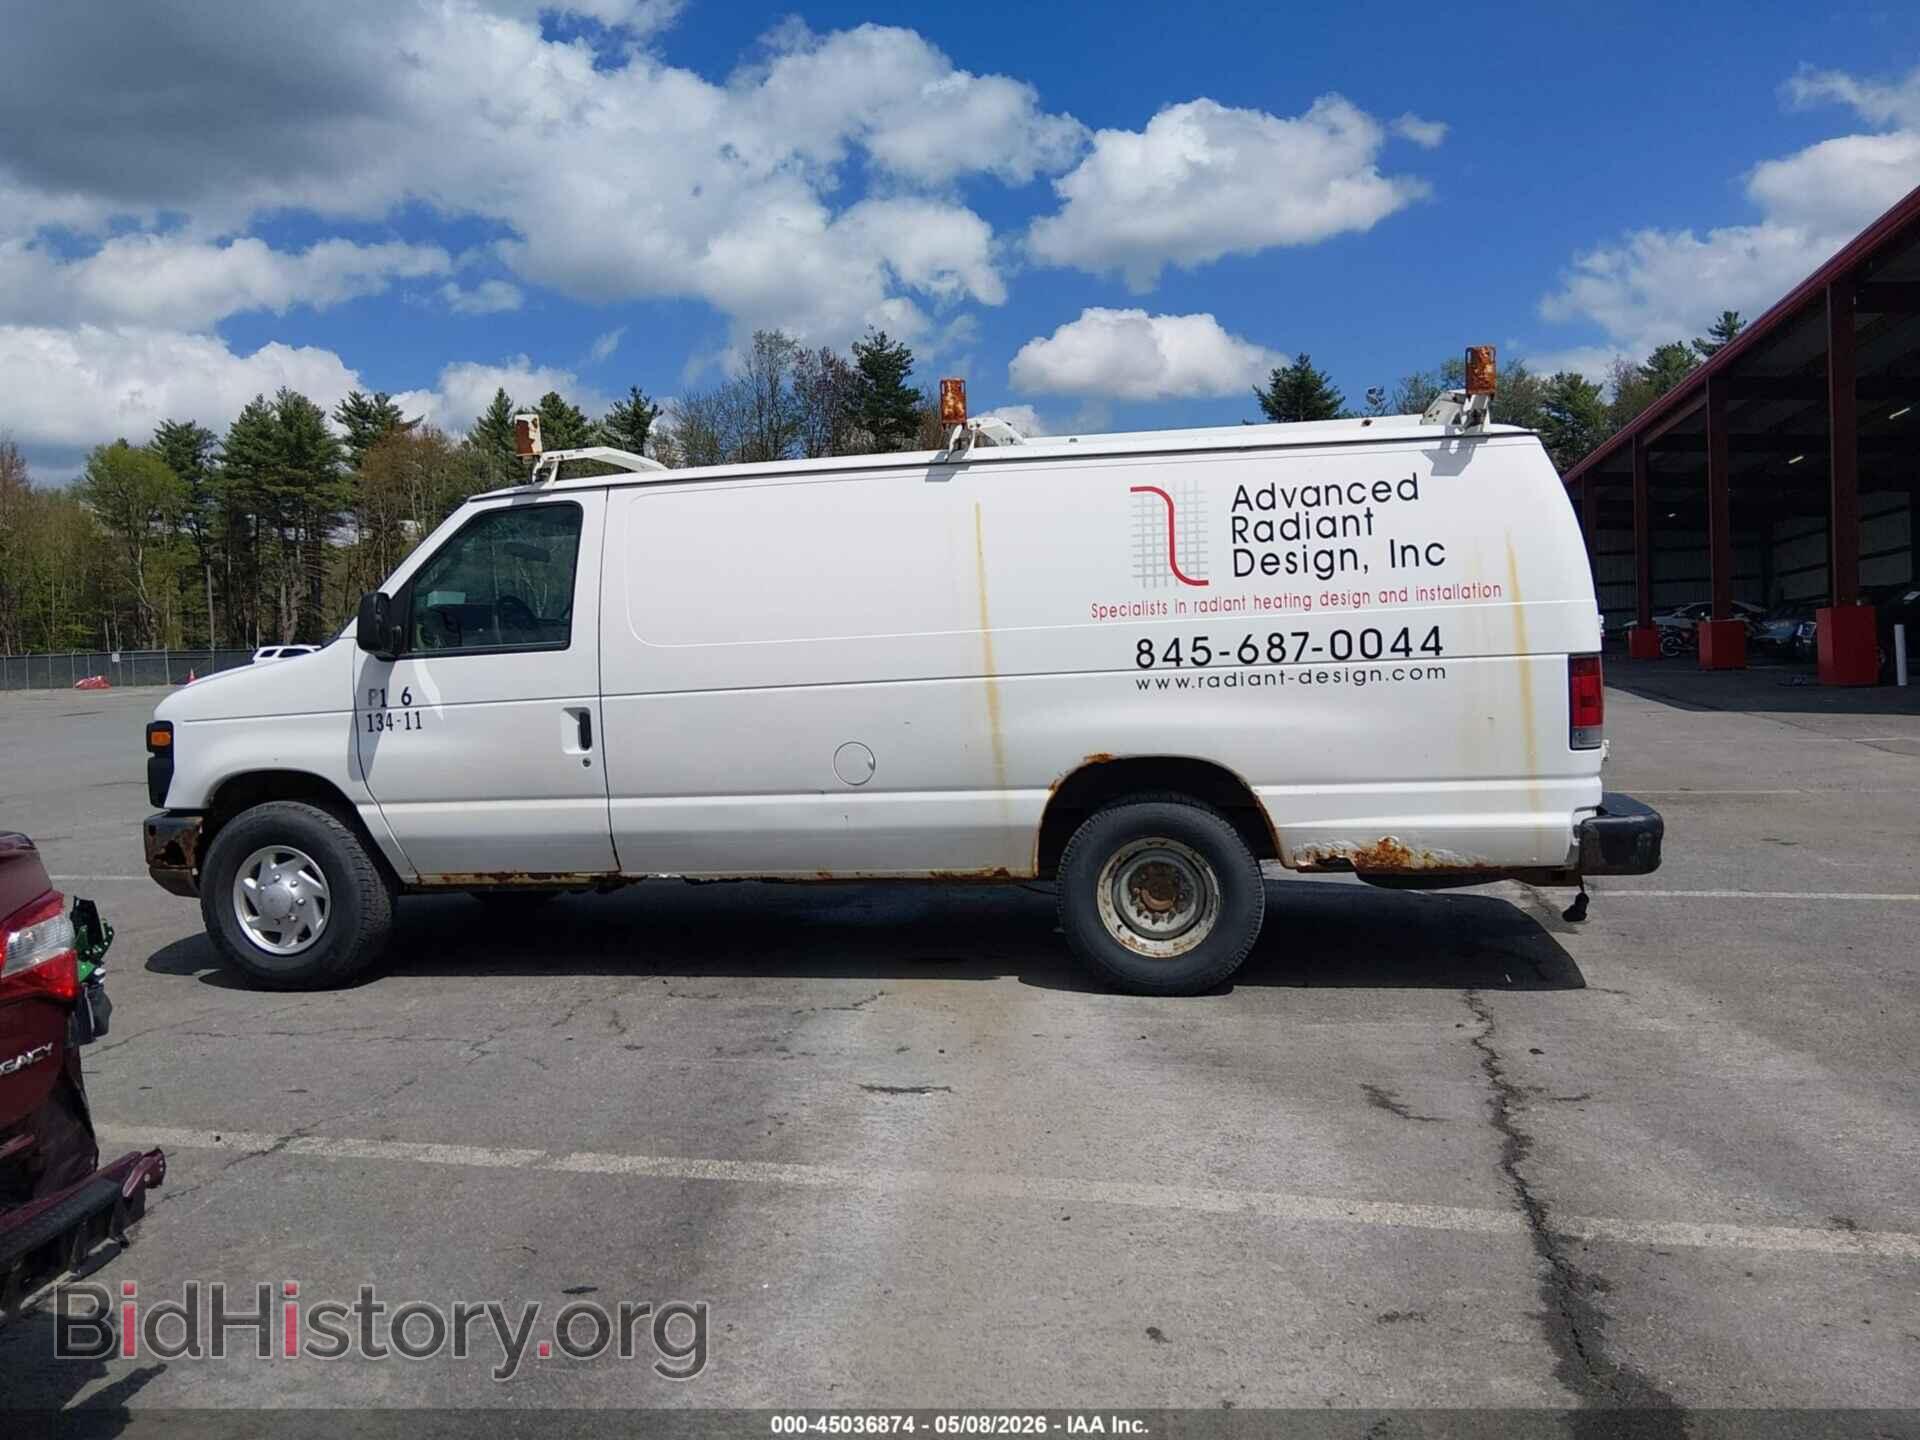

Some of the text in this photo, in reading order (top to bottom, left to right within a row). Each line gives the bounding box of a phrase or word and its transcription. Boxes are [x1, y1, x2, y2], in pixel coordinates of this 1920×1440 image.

[1231, 472, 1419, 513] Advanced
[1231, 507, 1374, 544] Radiant
[1233, 538, 1446, 581] Design, Inc
[1091, 583, 1502, 621] Specialists in radiant heating design and installation
[1136, 625, 1444, 669] 845-687-0044
[1136, 666, 1447, 690] www.radiant-design.com
[366, 710, 423, 733] 134-11
